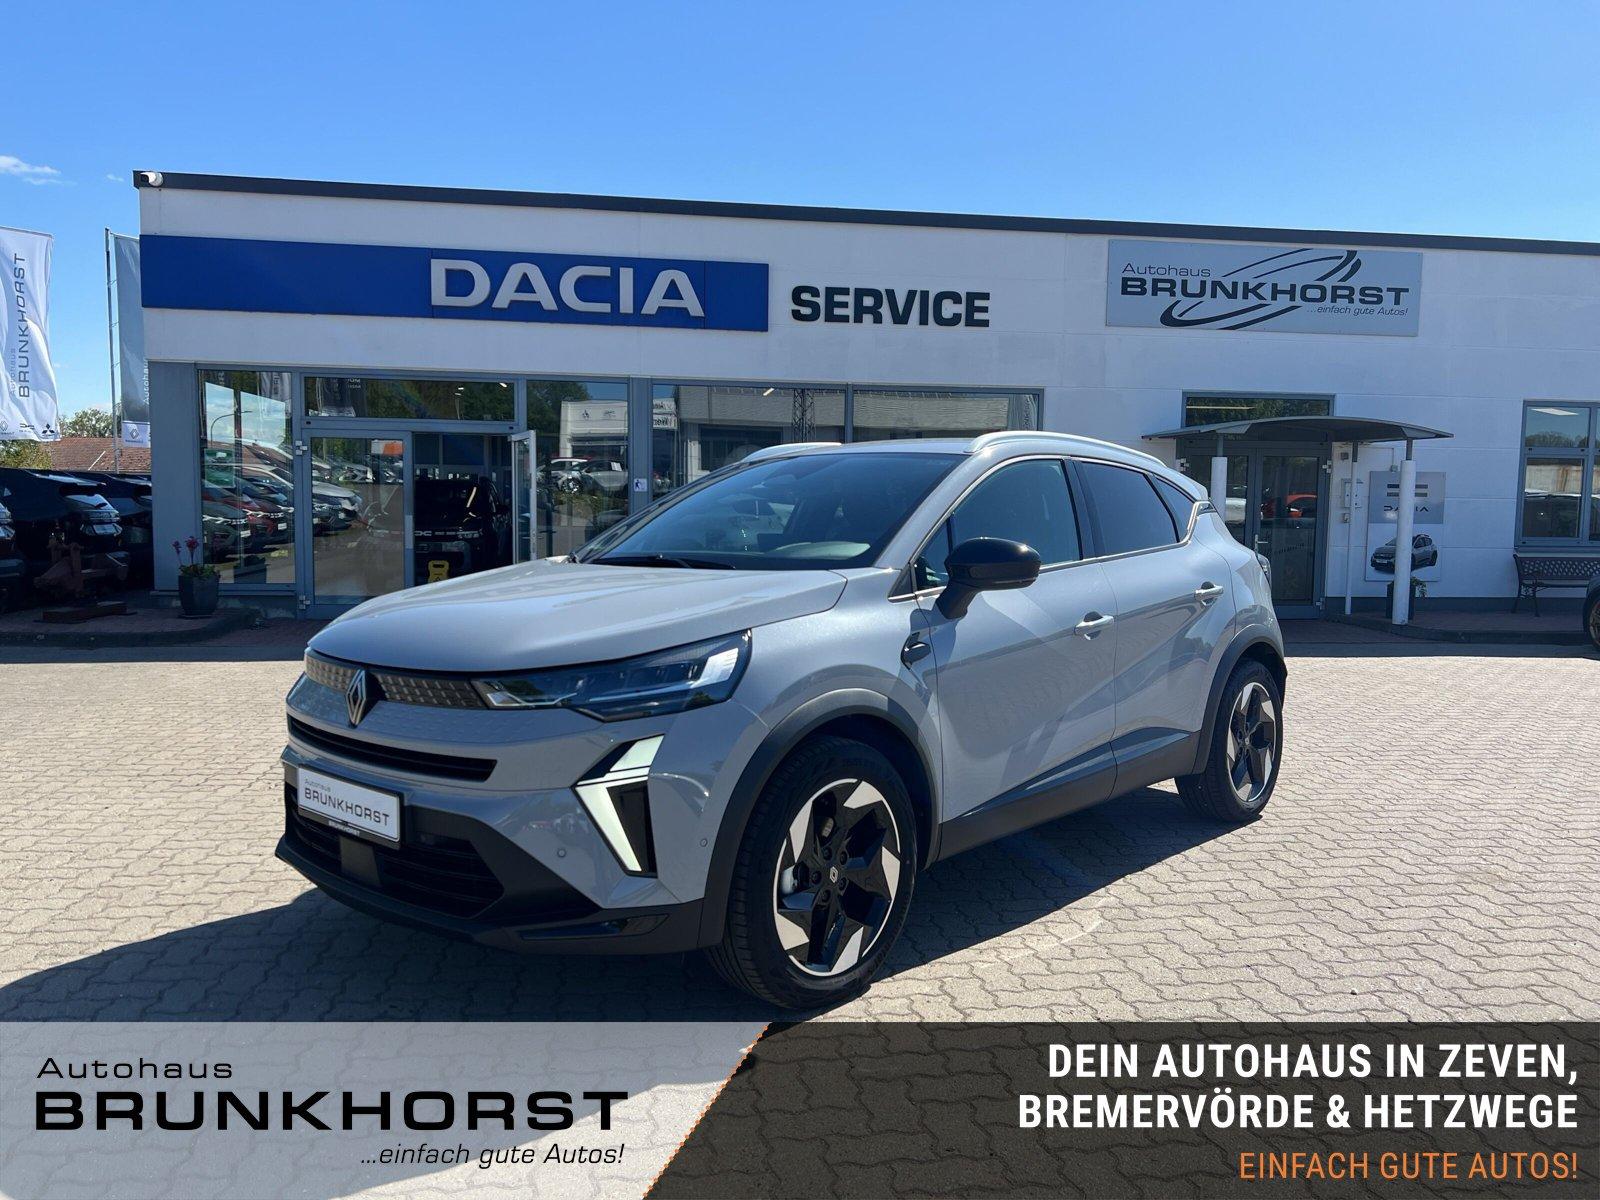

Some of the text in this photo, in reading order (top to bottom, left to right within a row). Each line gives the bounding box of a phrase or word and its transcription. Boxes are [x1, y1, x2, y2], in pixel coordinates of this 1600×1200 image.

[1121, 262, 1211, 278] Autohaus
[430, 258, 991, 328] DACIA SERVICE
[1120, 276, 1410, 306] BRUNKHORST
[14, 253, 30, 398] BRUNKHORST
[1353, 307, 1375, 317] gute
[1377, 306, 1409, 316] Autos!
[1383, 504, 1429, 513] DIA
[304, 787, 390, 827] BRUNKHORST
